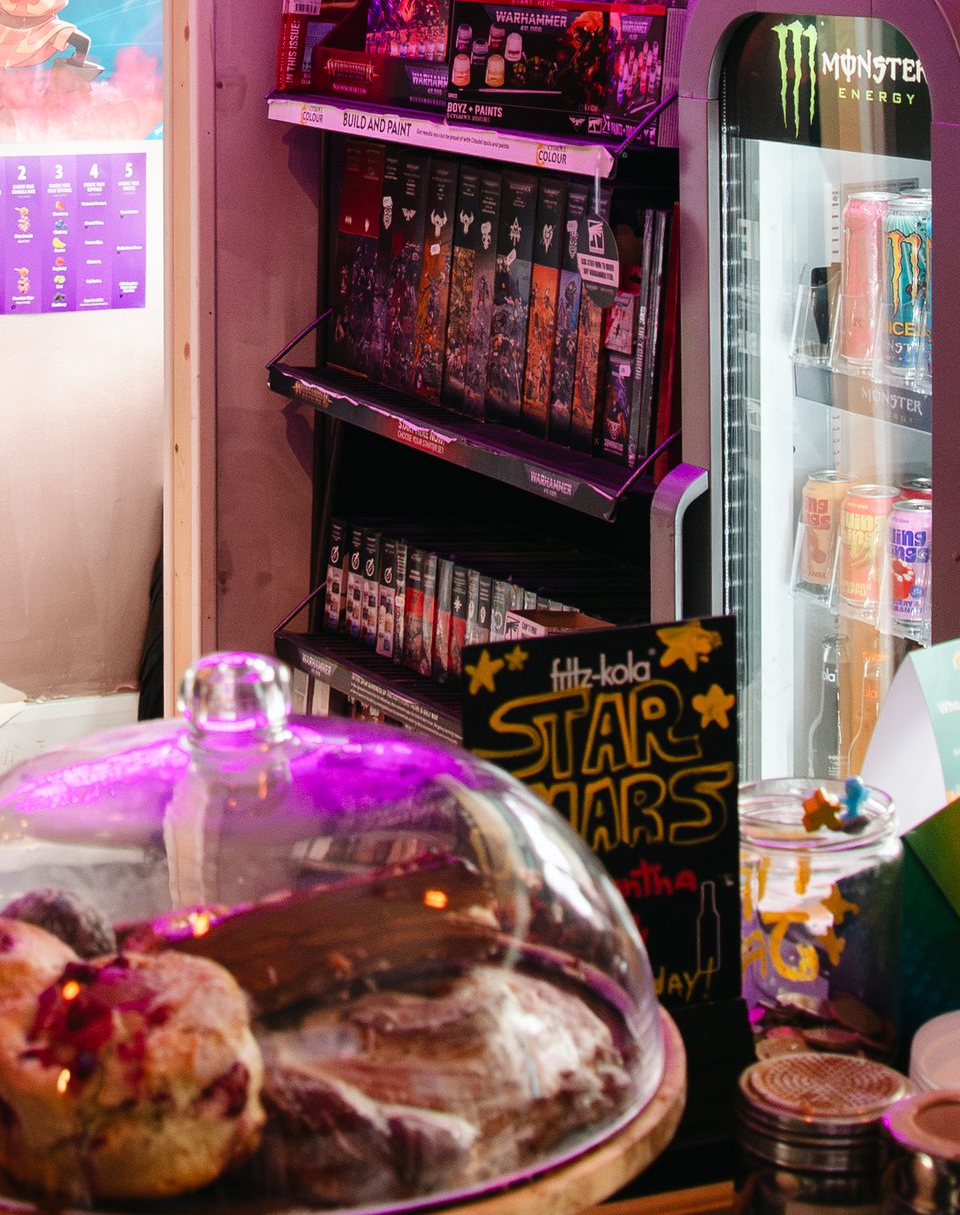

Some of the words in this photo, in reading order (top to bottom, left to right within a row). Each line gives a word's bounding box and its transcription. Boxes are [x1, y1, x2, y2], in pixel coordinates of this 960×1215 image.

[496, 10, 567, 28] WARHAMMER
[837, 87, 917, 106] ENERGY
[303, 111, 323, 123] COLOUR
[447, 102, 467, 114] BOYZ
[475, 105, 503, 117] PAINTS
[343, 113, 366, 129] BUILD
[368, 119, 386, 133] AND
[387, 121, 412, 137] PAINT
[538, 150, 567, 165] COLOUR
[18, 165, 27, 180] 2
[55, 164, 64, 180] 3
[89, 163, 99, 179] 4
[124, 162, 134, 178] 5
[530, 471, 572, 496] WARHAMMER
[472, 679, 703, 781] STAR
